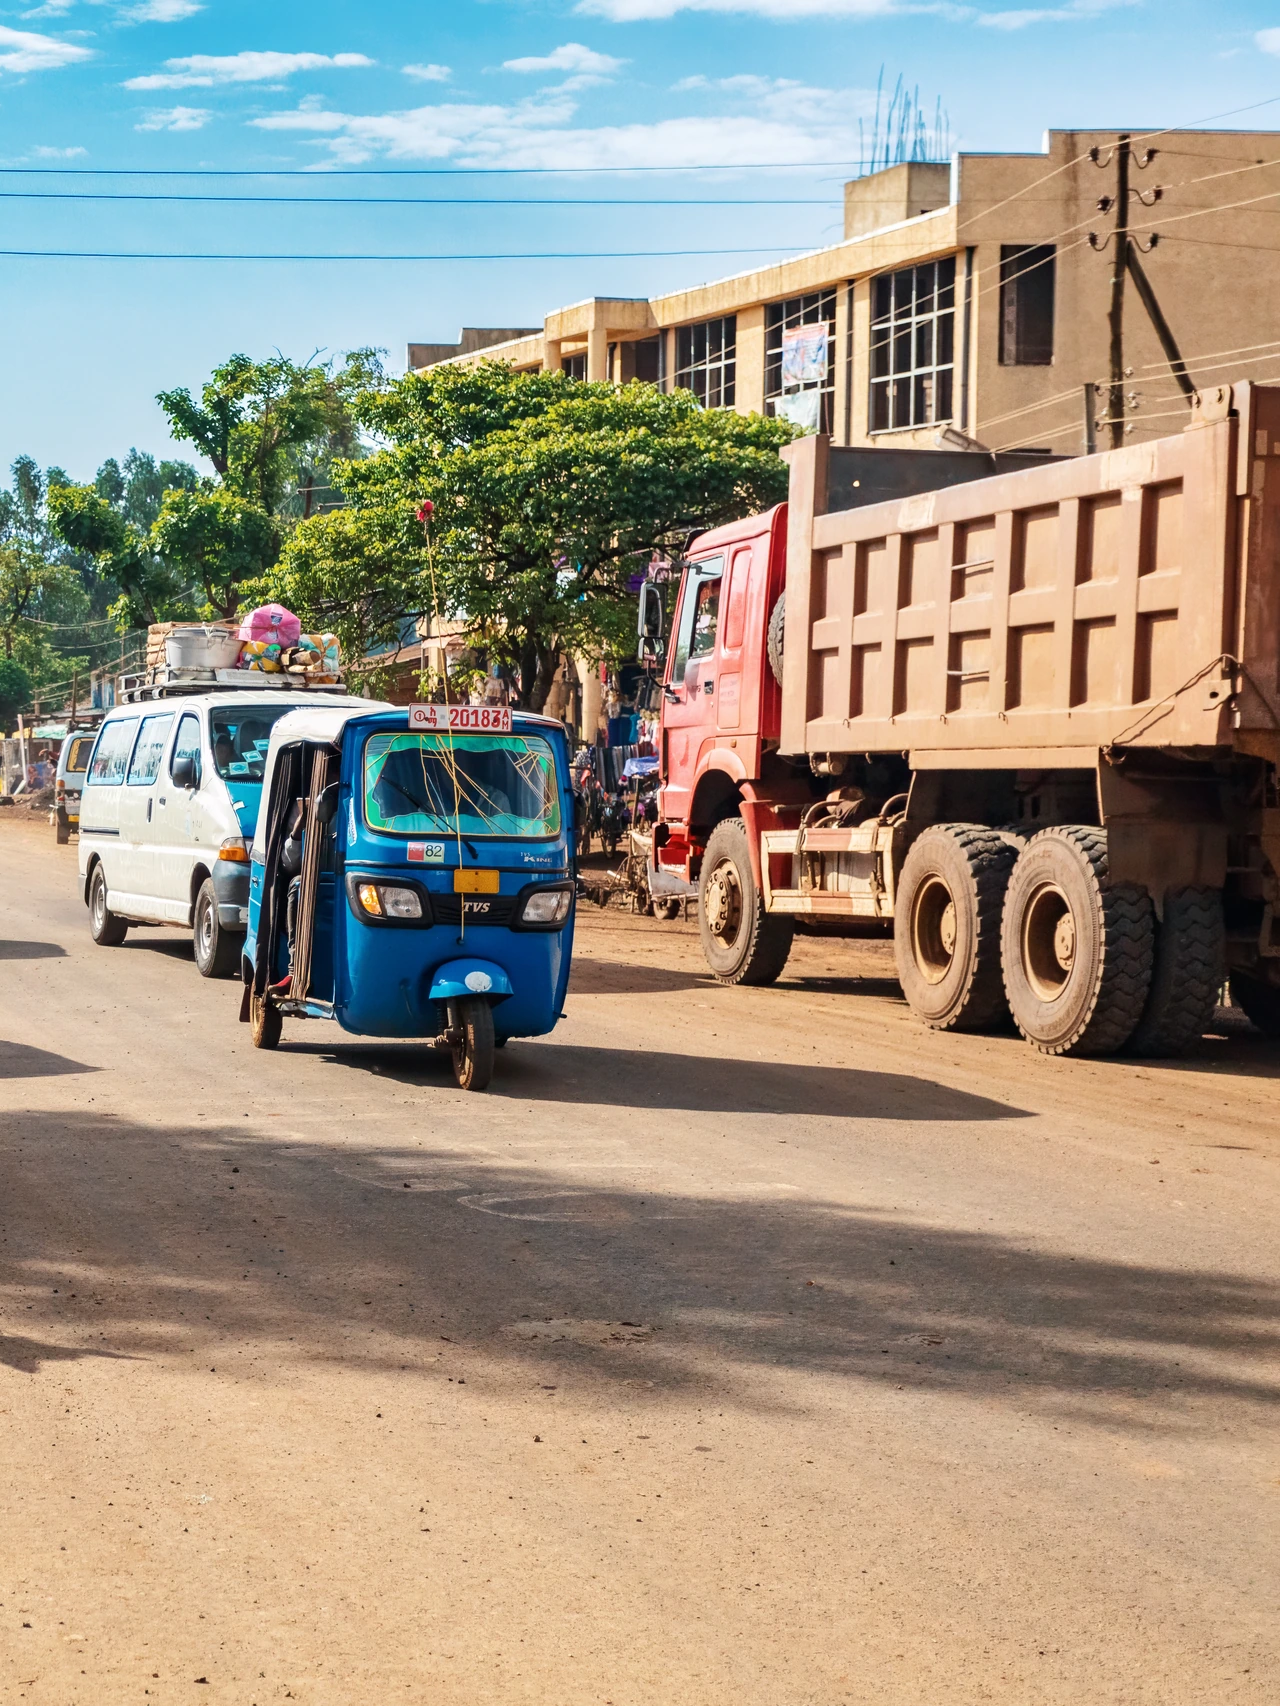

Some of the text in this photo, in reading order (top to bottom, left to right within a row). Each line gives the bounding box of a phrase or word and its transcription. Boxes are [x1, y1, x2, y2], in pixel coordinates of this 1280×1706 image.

[449, 708, 500, 728] 20183
[425, 844, 443, 858] 82
[463, 901, 491, 913] TVS
